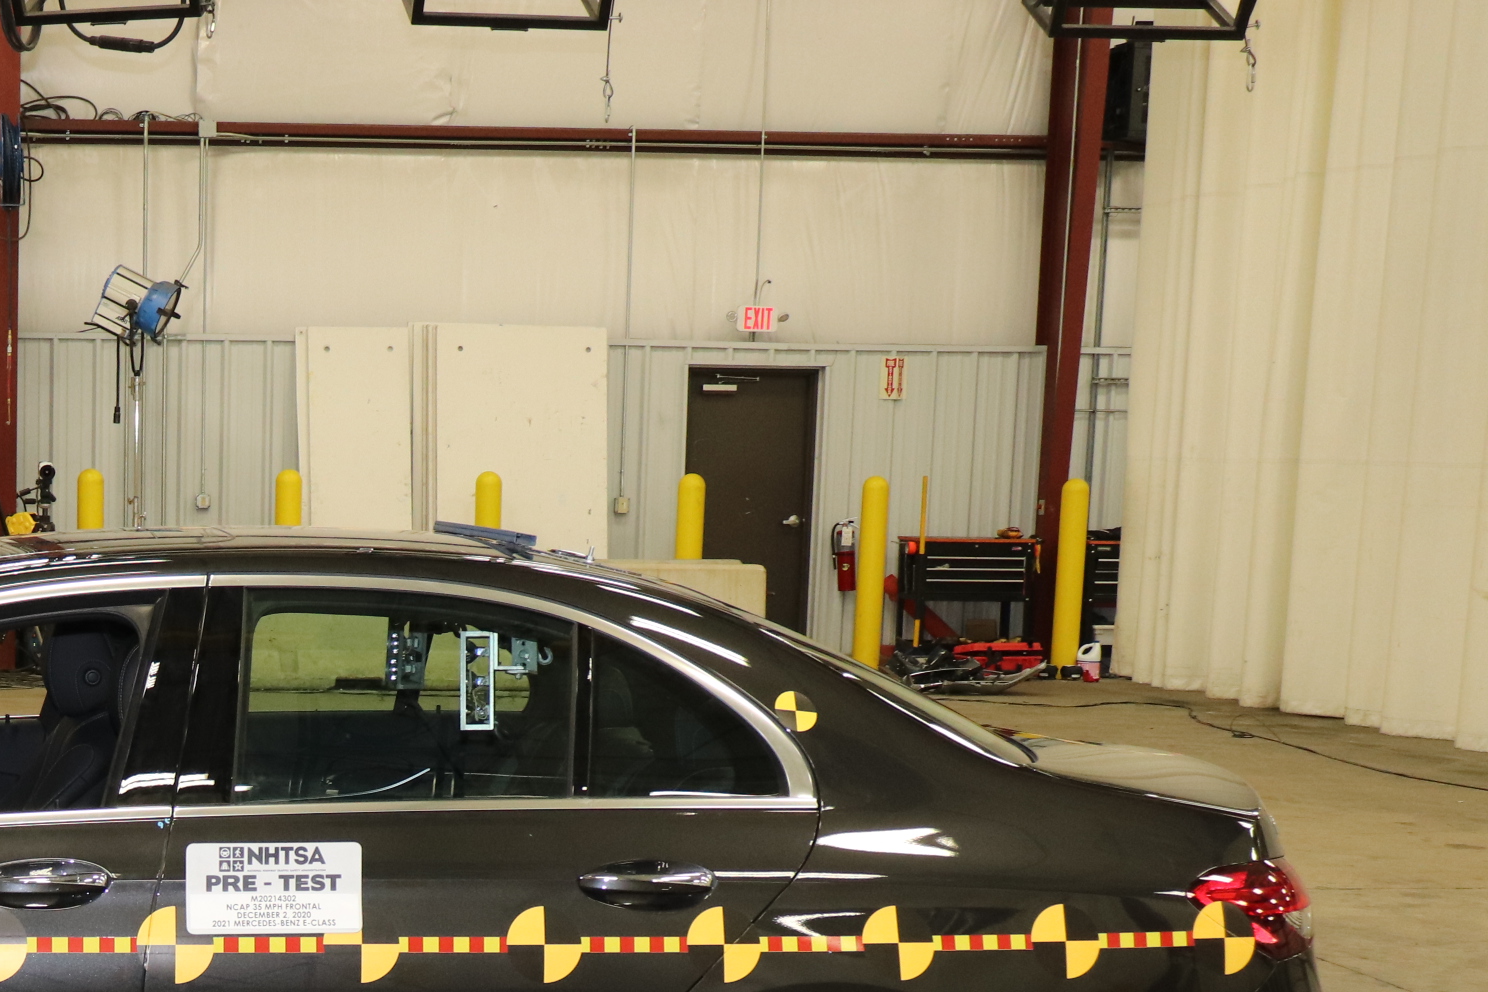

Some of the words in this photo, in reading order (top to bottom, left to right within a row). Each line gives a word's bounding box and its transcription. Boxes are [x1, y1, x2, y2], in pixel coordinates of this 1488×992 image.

[744, 307, 773, 330] EXIT
[247, 846, 326, 865] NHTSA
[206, 874, 258, 892] PRE
[278, 874, 342, 892] TEST
